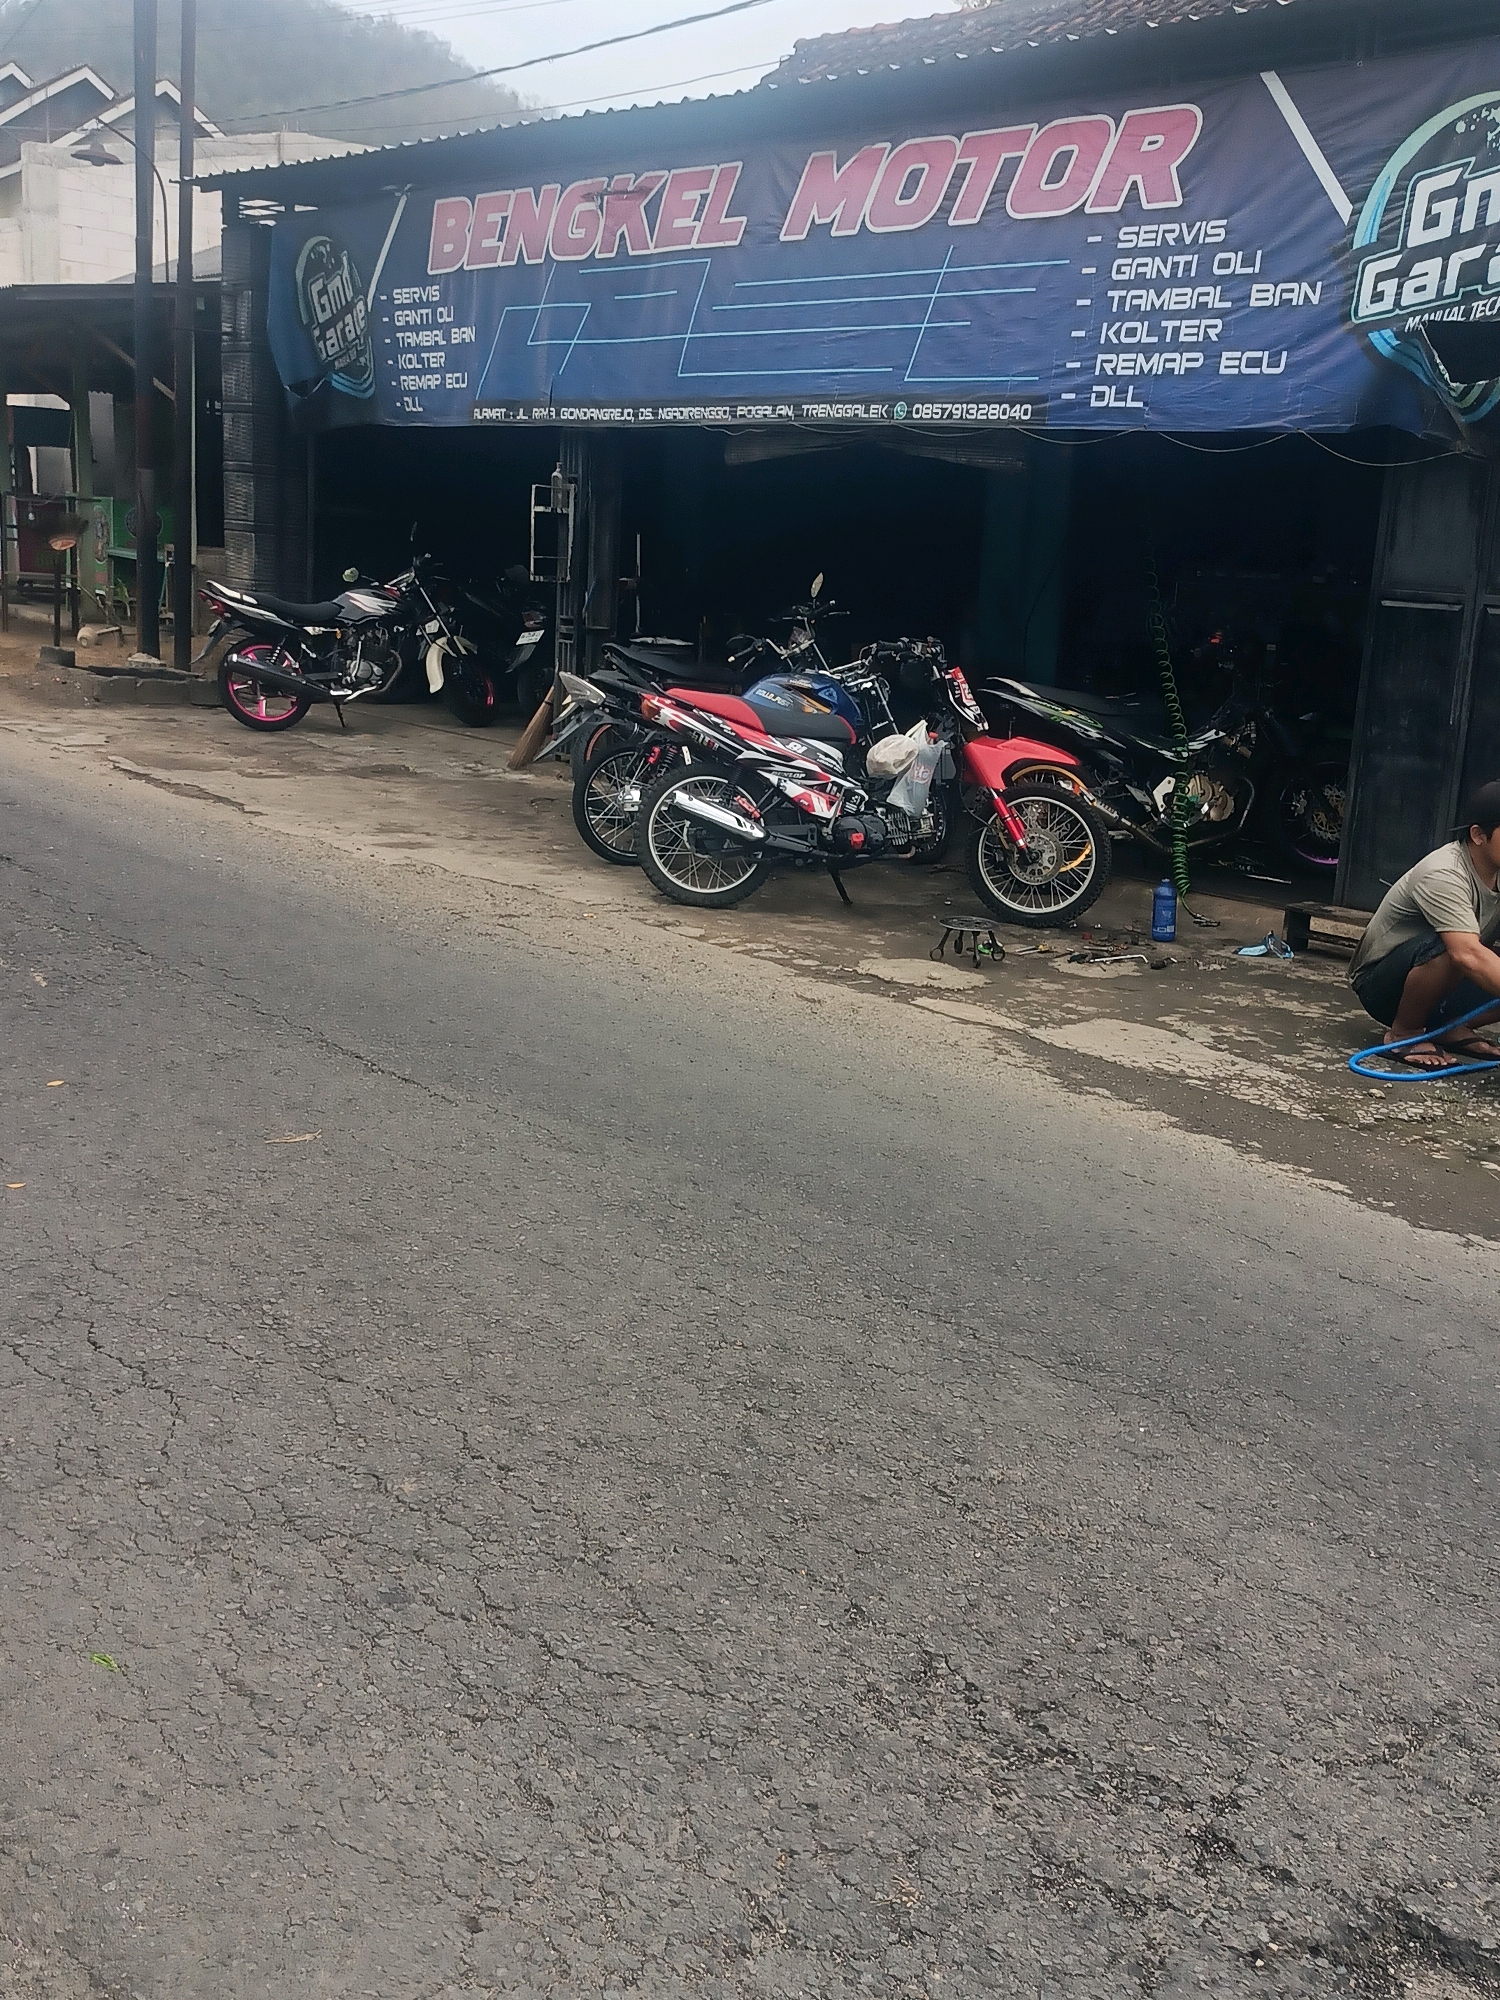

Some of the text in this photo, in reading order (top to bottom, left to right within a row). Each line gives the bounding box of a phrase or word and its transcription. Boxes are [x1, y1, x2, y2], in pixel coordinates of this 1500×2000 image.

[427, 103, 1202, 275] BENGKEL MOTOR
[1117, 219, 1228, 249] SERVIS
[1111, 254, 1199, 281] GANTI
[1212, 249, 1262, 275] OLI
[393, 285, 440, 305] SERVIS
[1107, 286, 1232, 313] TAMBAL
[1250, 281, 1323, 307] BAN
[394, 308, 432, 327] GANTI
[436, 305, 454, 323] OLI
[396, 329, 447, 348] TAMBAL
[451, 325, 476, 344] BAN
[1100, 318, 1222, 344] KOLTER
[398, 351, 446, 370] KOLTER
[1094, 352, 1204, 376] REMAP
[1218, 350, 1287, 375] ECU
[400, 373, 441, 391] REMAP
[445, 371, 468, 389] ECU
[1090, 385, 1144, 408] DLL
[473, 407, 506, 420] ALAMAT
[801, 404, 888, 418] TRENGGALEK
[912, 403, 1032, 420] 085791328040
[770, 771, 807, 779] DUNLOP
